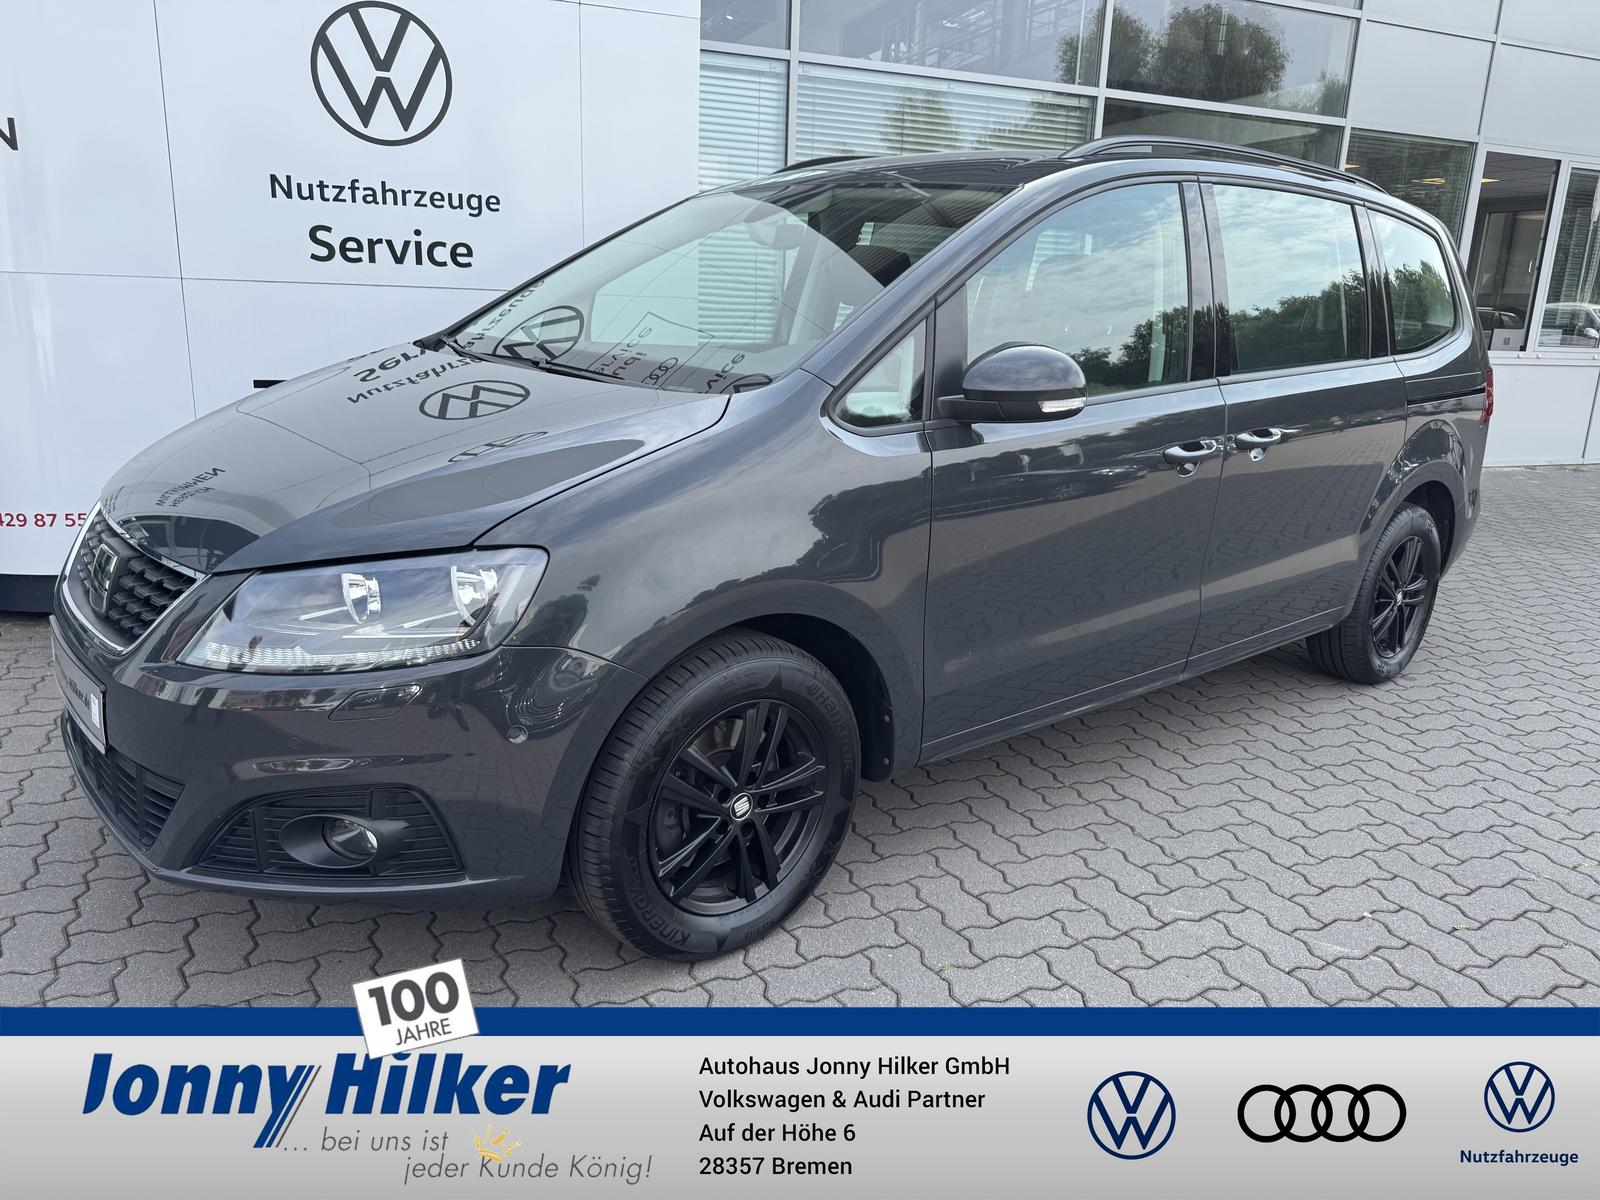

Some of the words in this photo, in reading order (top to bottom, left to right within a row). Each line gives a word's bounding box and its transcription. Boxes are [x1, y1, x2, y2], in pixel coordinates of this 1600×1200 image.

[269, 173, 501, 217] Nutzfahrzeuge
[308, 224, 474, 268] Service
[34, 513, 57, 527] 87
